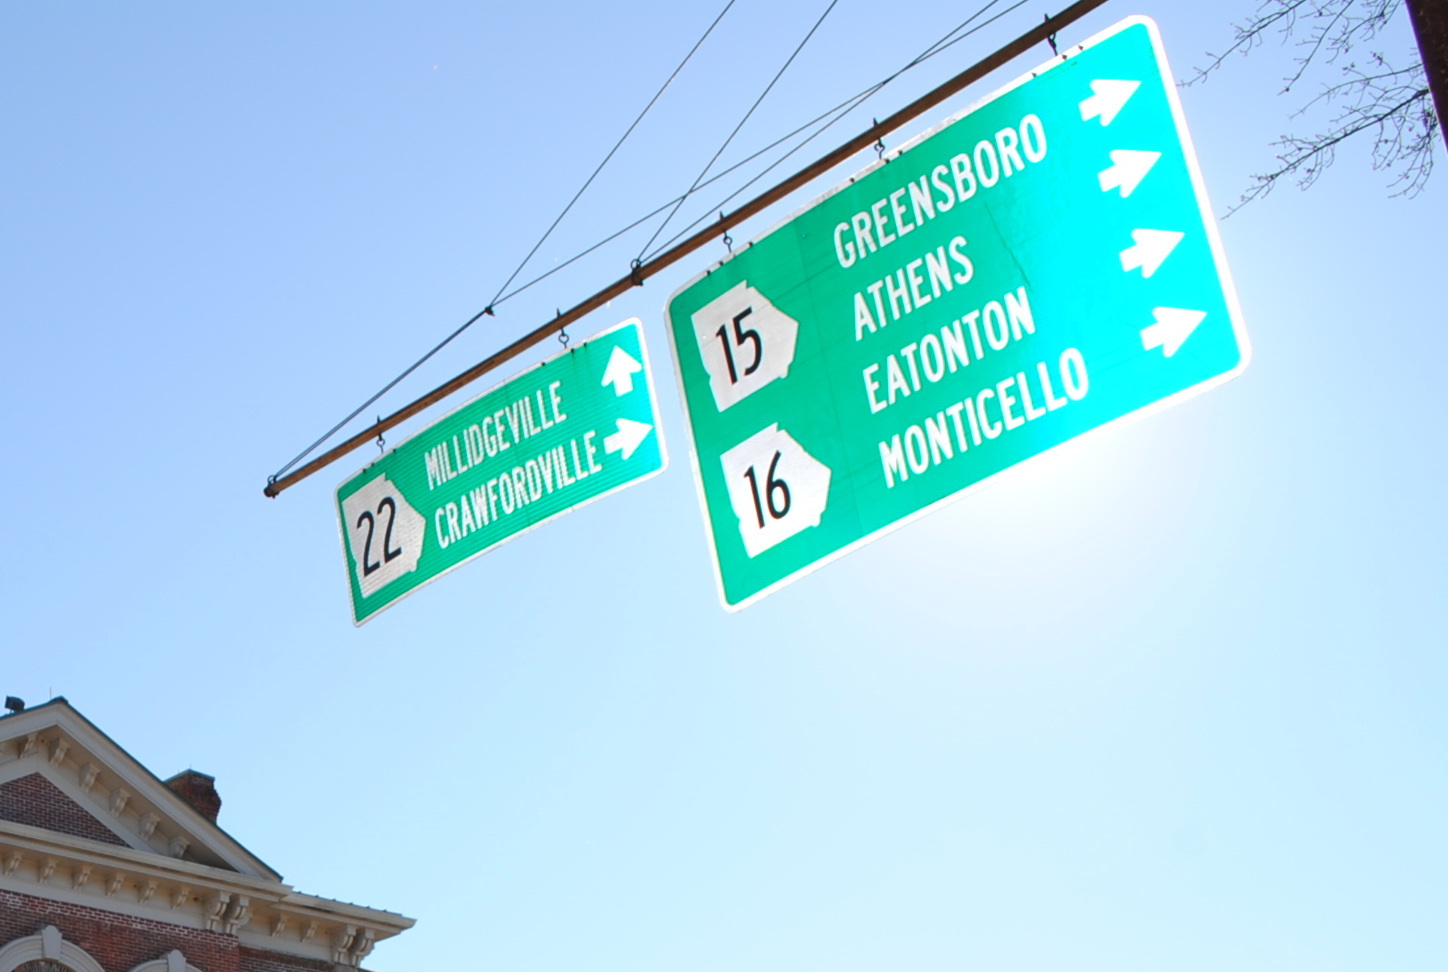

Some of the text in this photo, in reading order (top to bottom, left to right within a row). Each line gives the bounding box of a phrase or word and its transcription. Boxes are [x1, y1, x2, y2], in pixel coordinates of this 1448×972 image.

[833, 113, 1048, 269] GREENSBORO
[852, 235, 974, 342] ATHENS
[715, 307, 763, 386] 15
[862, 285, 1036, 415] EATONTON
[423, 380, 568, 491] MILLIDGEVILLE
[878, 346, 1090, 489] MONTICELLO
[356, 496, 402, 578] 22
[434, 430, 603, 550] CRAWFORDVILLE
[743, 450, 792, 529] 16
